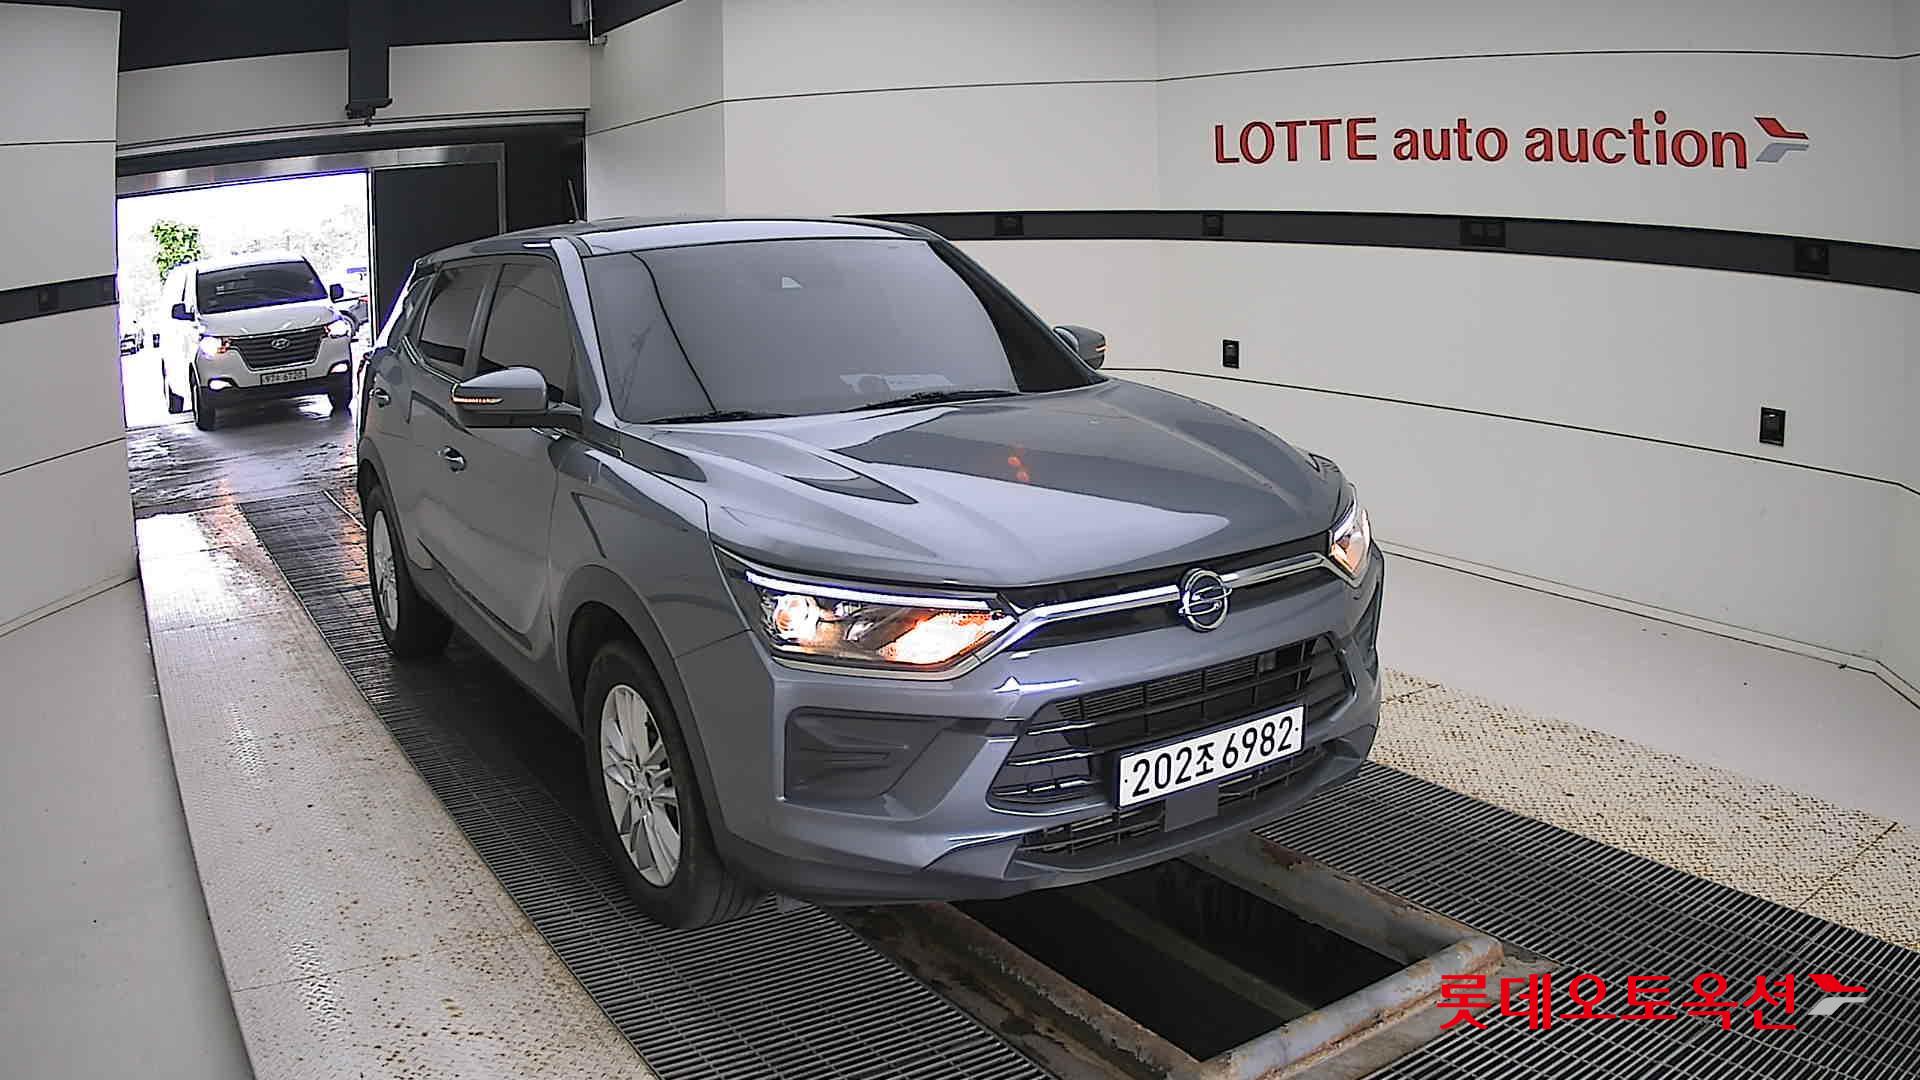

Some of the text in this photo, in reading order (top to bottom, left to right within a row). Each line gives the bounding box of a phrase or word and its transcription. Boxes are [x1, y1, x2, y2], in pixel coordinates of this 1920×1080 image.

[1215, 111, 1747, 168] LOTTE auto auction
[1222, 716, 1293, 768] 6982
